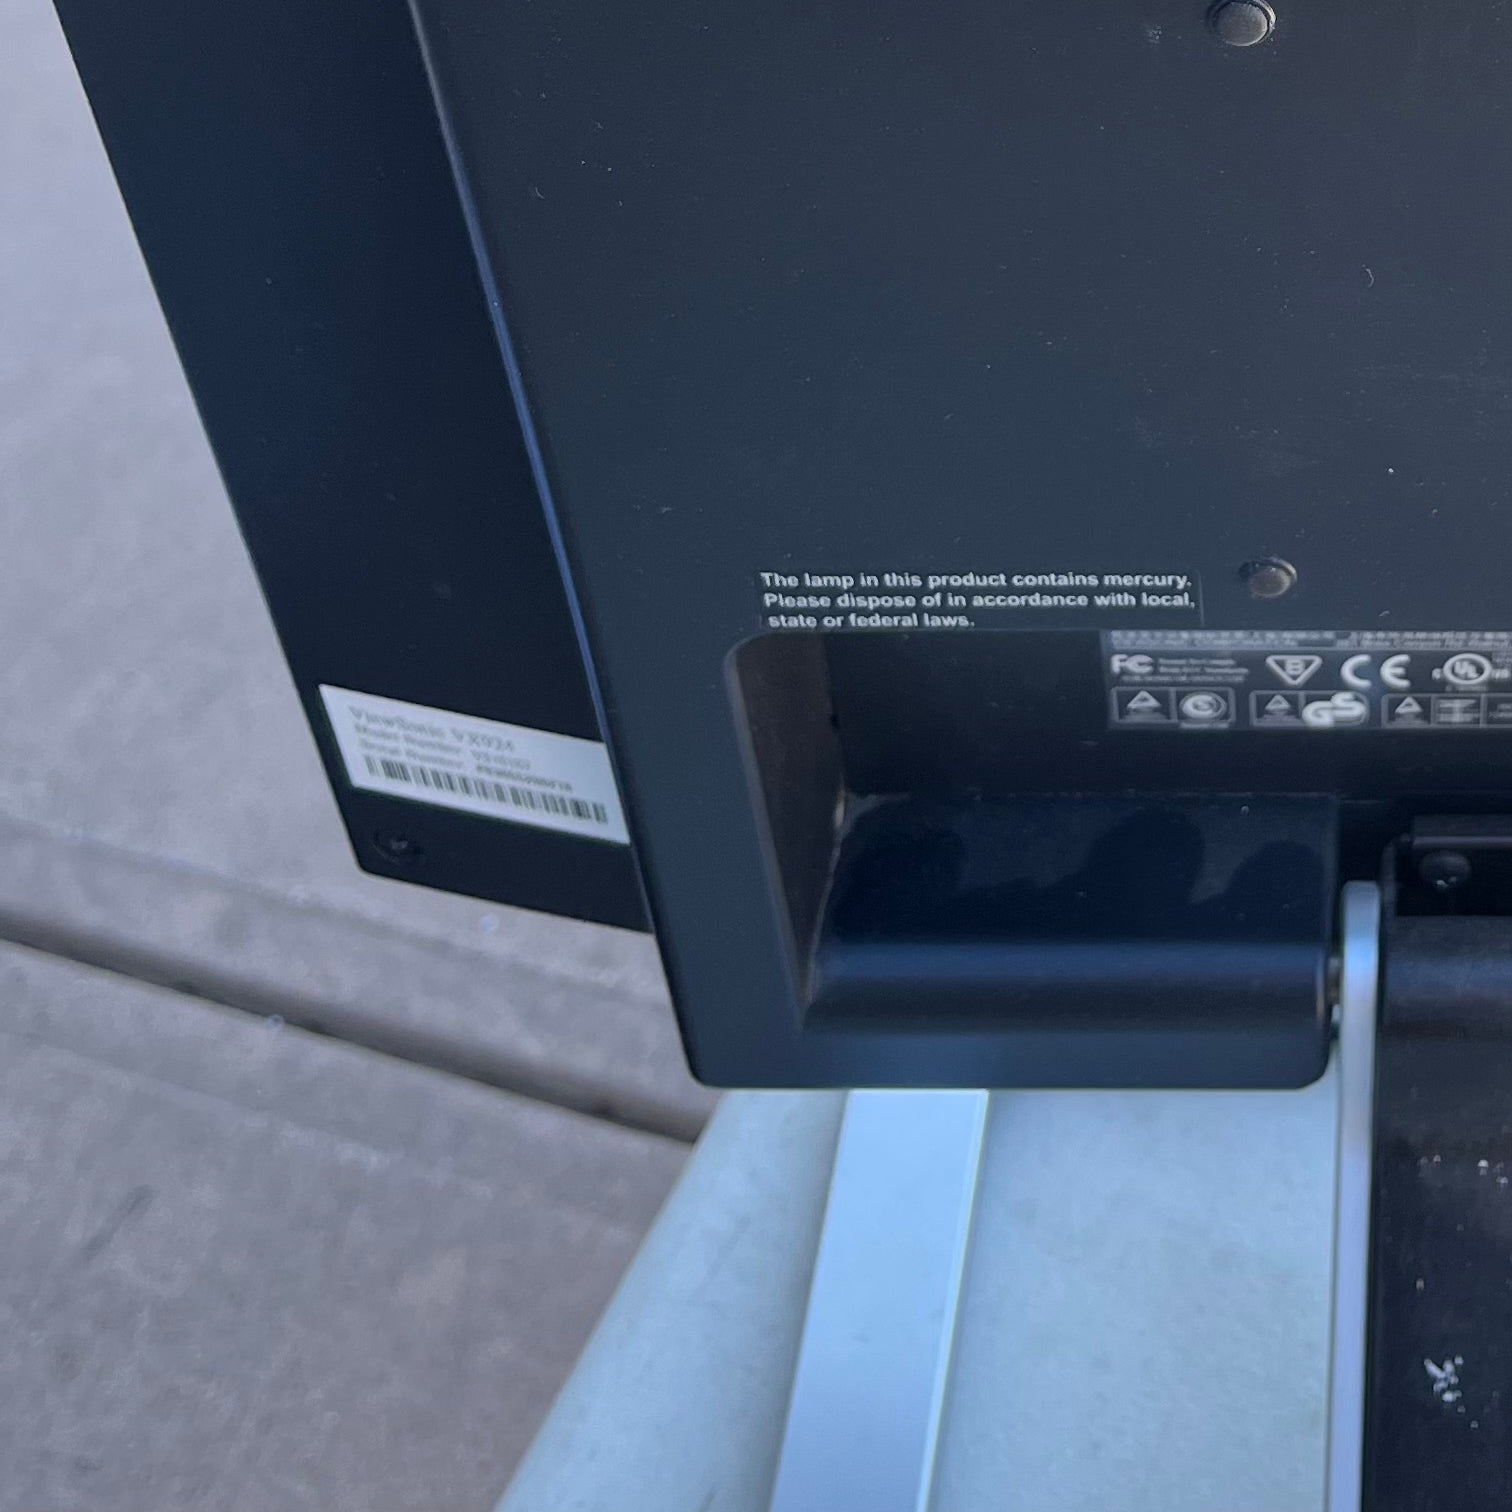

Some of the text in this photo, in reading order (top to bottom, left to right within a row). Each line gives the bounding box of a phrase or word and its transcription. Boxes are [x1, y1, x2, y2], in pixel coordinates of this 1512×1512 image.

[760, 571, 1192, 590] The lamp in this product contains mercury.
[763, 592, 831, 607] Please
[836, 592, 916, 610] dispose
[921, 592, 942, 607] of
[947, 592, 967, 607] in
[972, 592, 1089, 607] accordance
[1093, 592, 1136, 607] with
[768, 612, 976, 628] state or federal laws.
